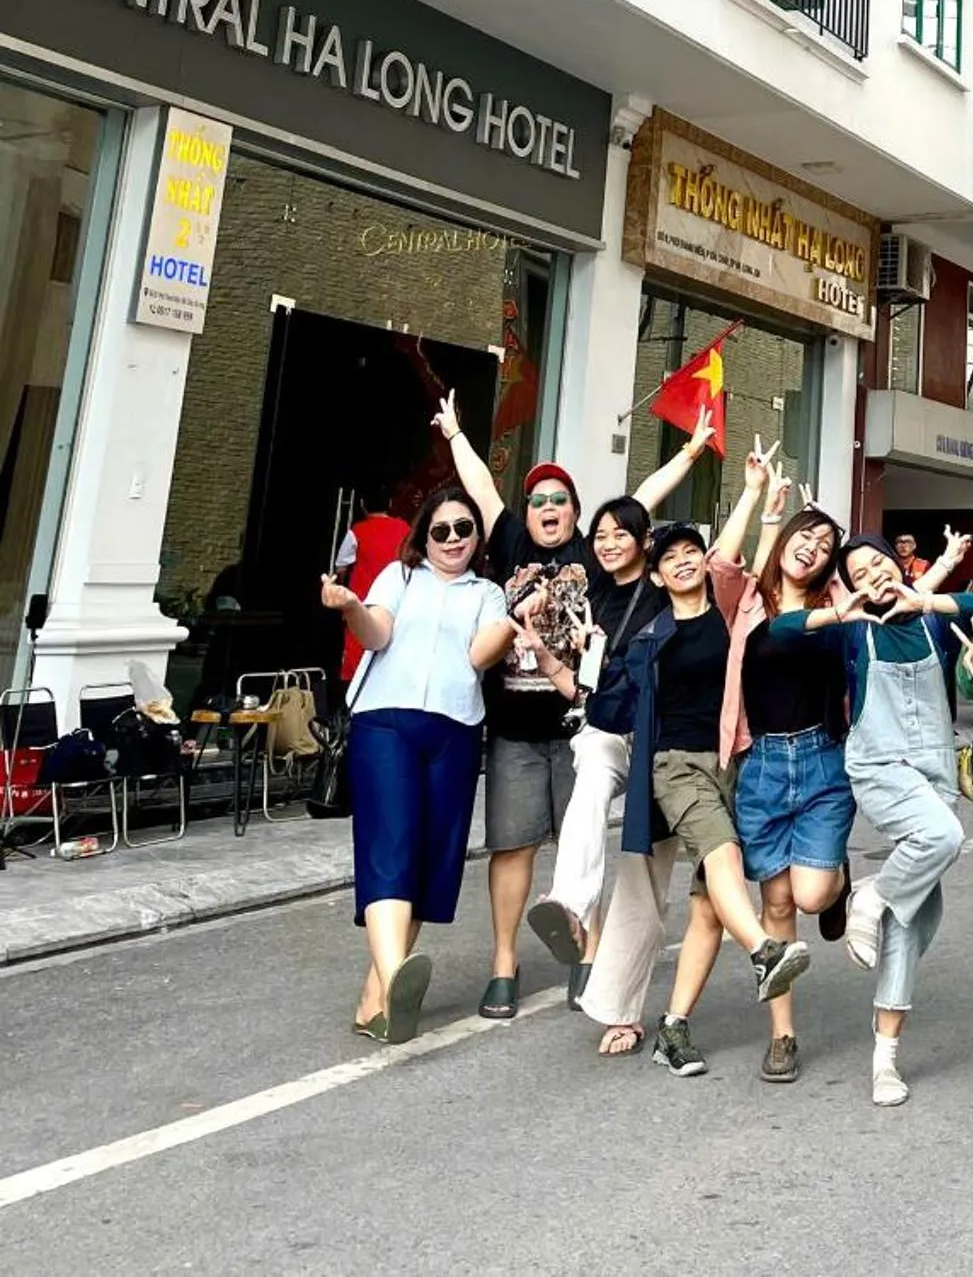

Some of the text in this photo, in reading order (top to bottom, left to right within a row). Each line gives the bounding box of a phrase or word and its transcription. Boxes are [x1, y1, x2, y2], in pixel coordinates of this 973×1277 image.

[281, 6, 347, 88] HA
[360, 40, 474, 132] LONG
[482, 93, 581, 180] HOTEL
[175, 217, 192, 249] 2
[360, 223, 462, 257] CENTRAL
[668, 163, 744, 231] THỐNG
[825, 234, 866, 281] LONG
[150, 254, 208, 287] HOTEL
[818, 278, 866, 318] HOTEL
